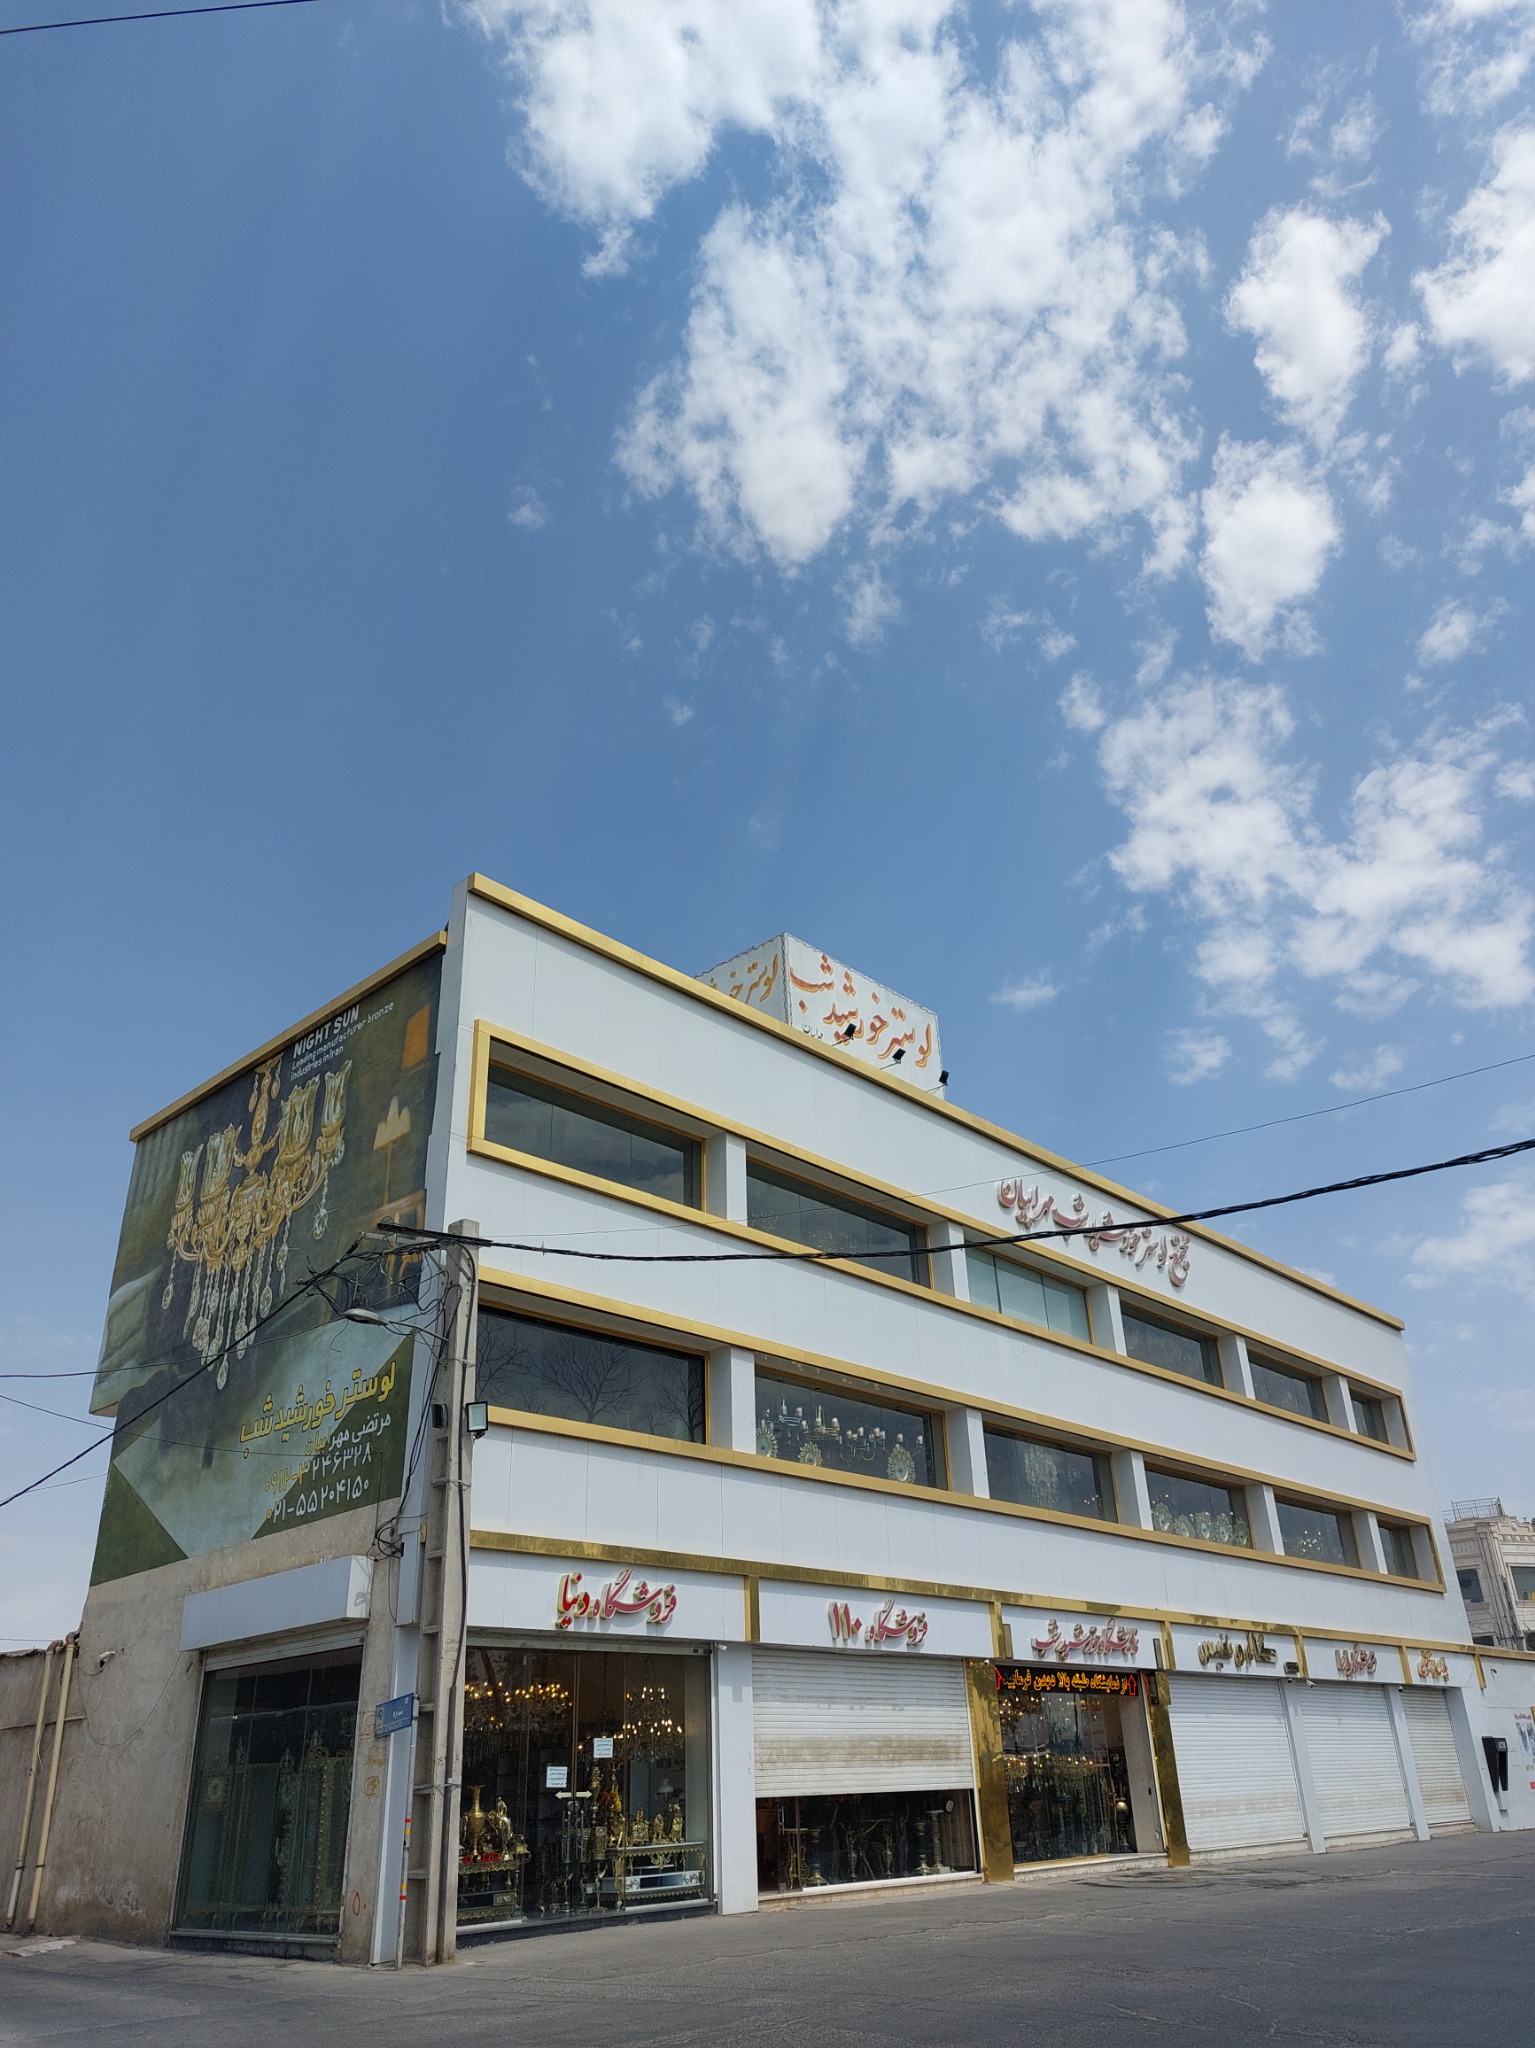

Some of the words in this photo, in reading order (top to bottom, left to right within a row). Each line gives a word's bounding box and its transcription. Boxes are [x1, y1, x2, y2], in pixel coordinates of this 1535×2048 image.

[789, 953, 836, 1014] شب
[293, 1021, 332, 1059] NIGHT
[333, 1004, 360, 1035] SUN
[822, 971, 889, 1046] خورشید
[292, 1051, 317, 1070] Leading
[316, 1018, 367, 1056] manufacturer
[367, 1002, 394, 1024] bronze
[877, 1006, 933, 1068] لوستر
[290, 1057, 322, 1081] industries
[1052, 1192, 1090, 1241] شب
[1135, 1226, 1168, 1268] لوستر
[274, 1380, 336, 1442] خورشید
[334, 1360, 397, 1421] لوستر
[239, 1393, 274, 1459] شب
[351, 1412, 392, 1444] مرتضی
[555, 1572, 590, 1628] دنیا
[587, 1569, 678, 1623] فروشگاه
[828, 1601, 863, 1640] ۱۱۰
[864, 1598, 928, 1646] فروشگاه
[1031, 1618, 1062, 1658] شب
[1055, 1623, 1102, 1661] خورشید
[1033, 1674, 1057, 1690] دیدن
[1057, 1671, 1071, 1691] بالا
[1071, 1672, 1090, 1692] طبقه
[1090, 1673, 1120, 1693] نمایشگاه
[1120, 1675, 1128, 1695] از
